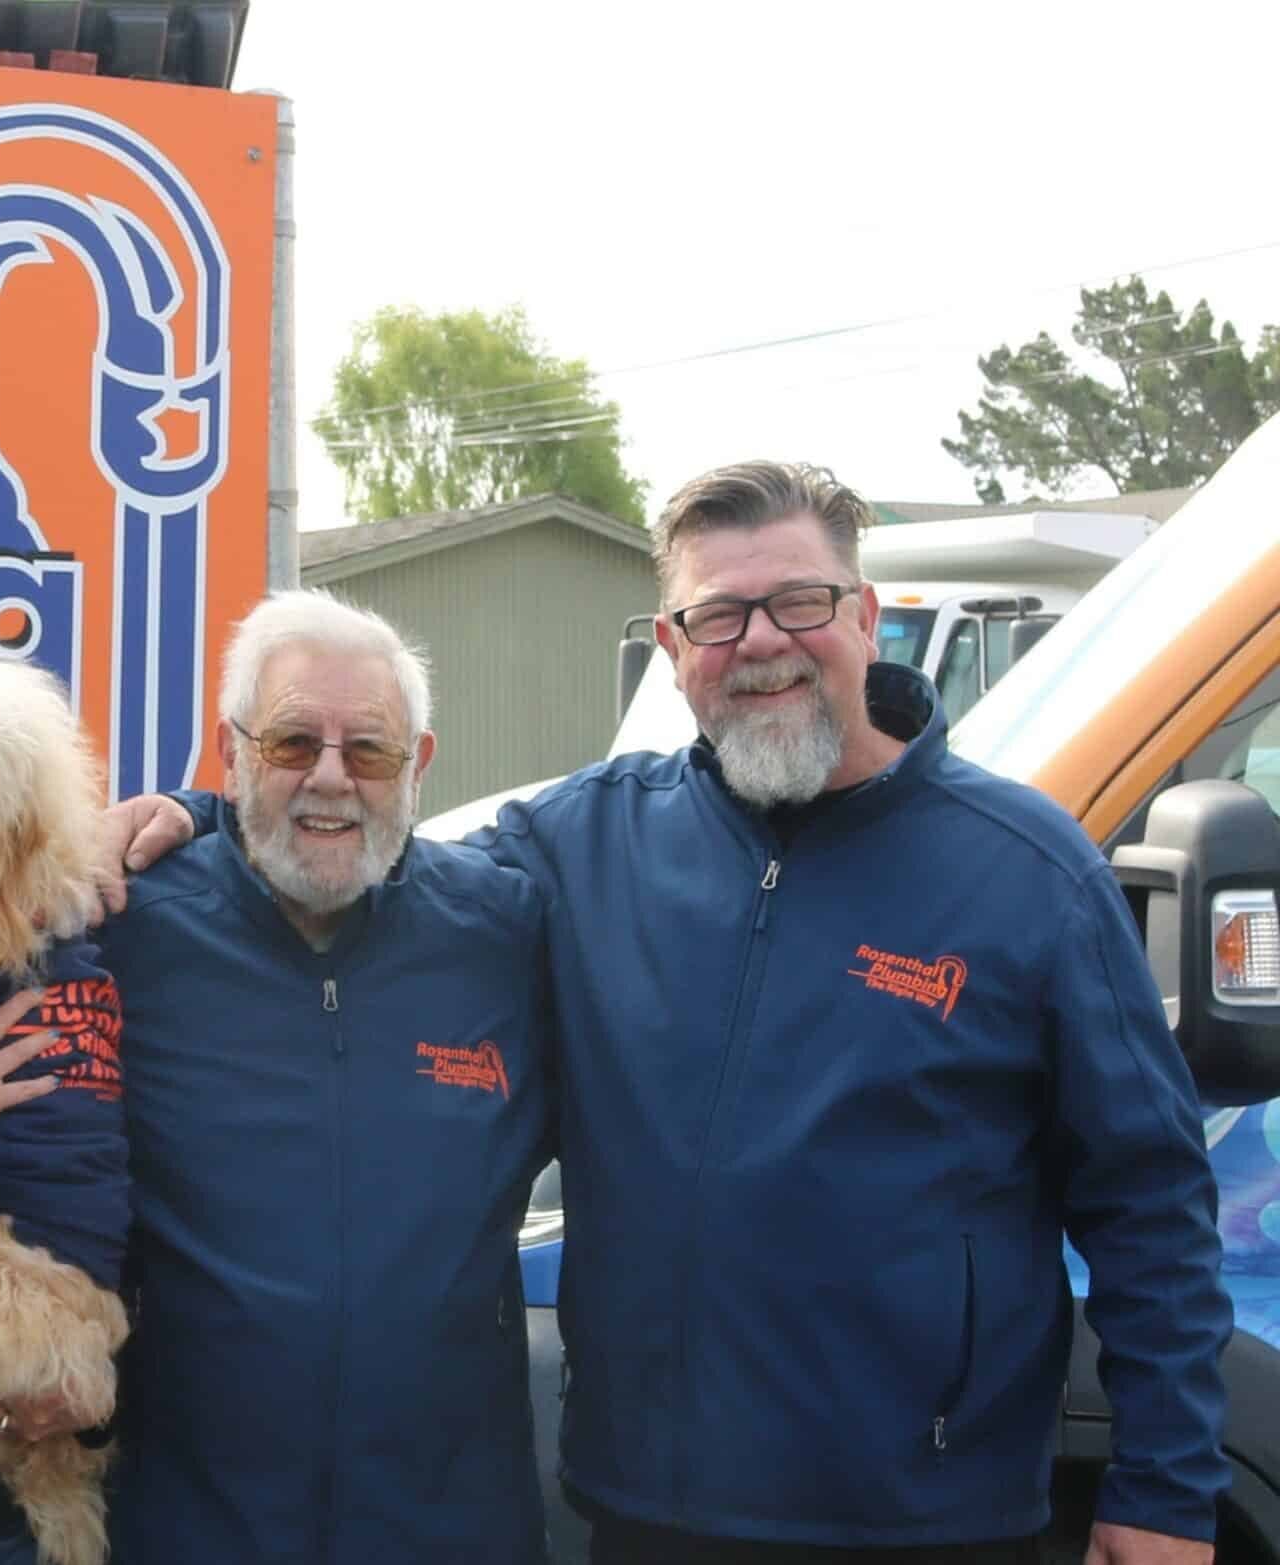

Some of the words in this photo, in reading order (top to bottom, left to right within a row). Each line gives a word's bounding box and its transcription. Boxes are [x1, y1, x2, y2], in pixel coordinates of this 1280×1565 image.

[855, 943, 939, 977] Rosenthal
[869, 961, 947, 999] Plumbing
[416, 1041, 485, 1064] Rosenthal
